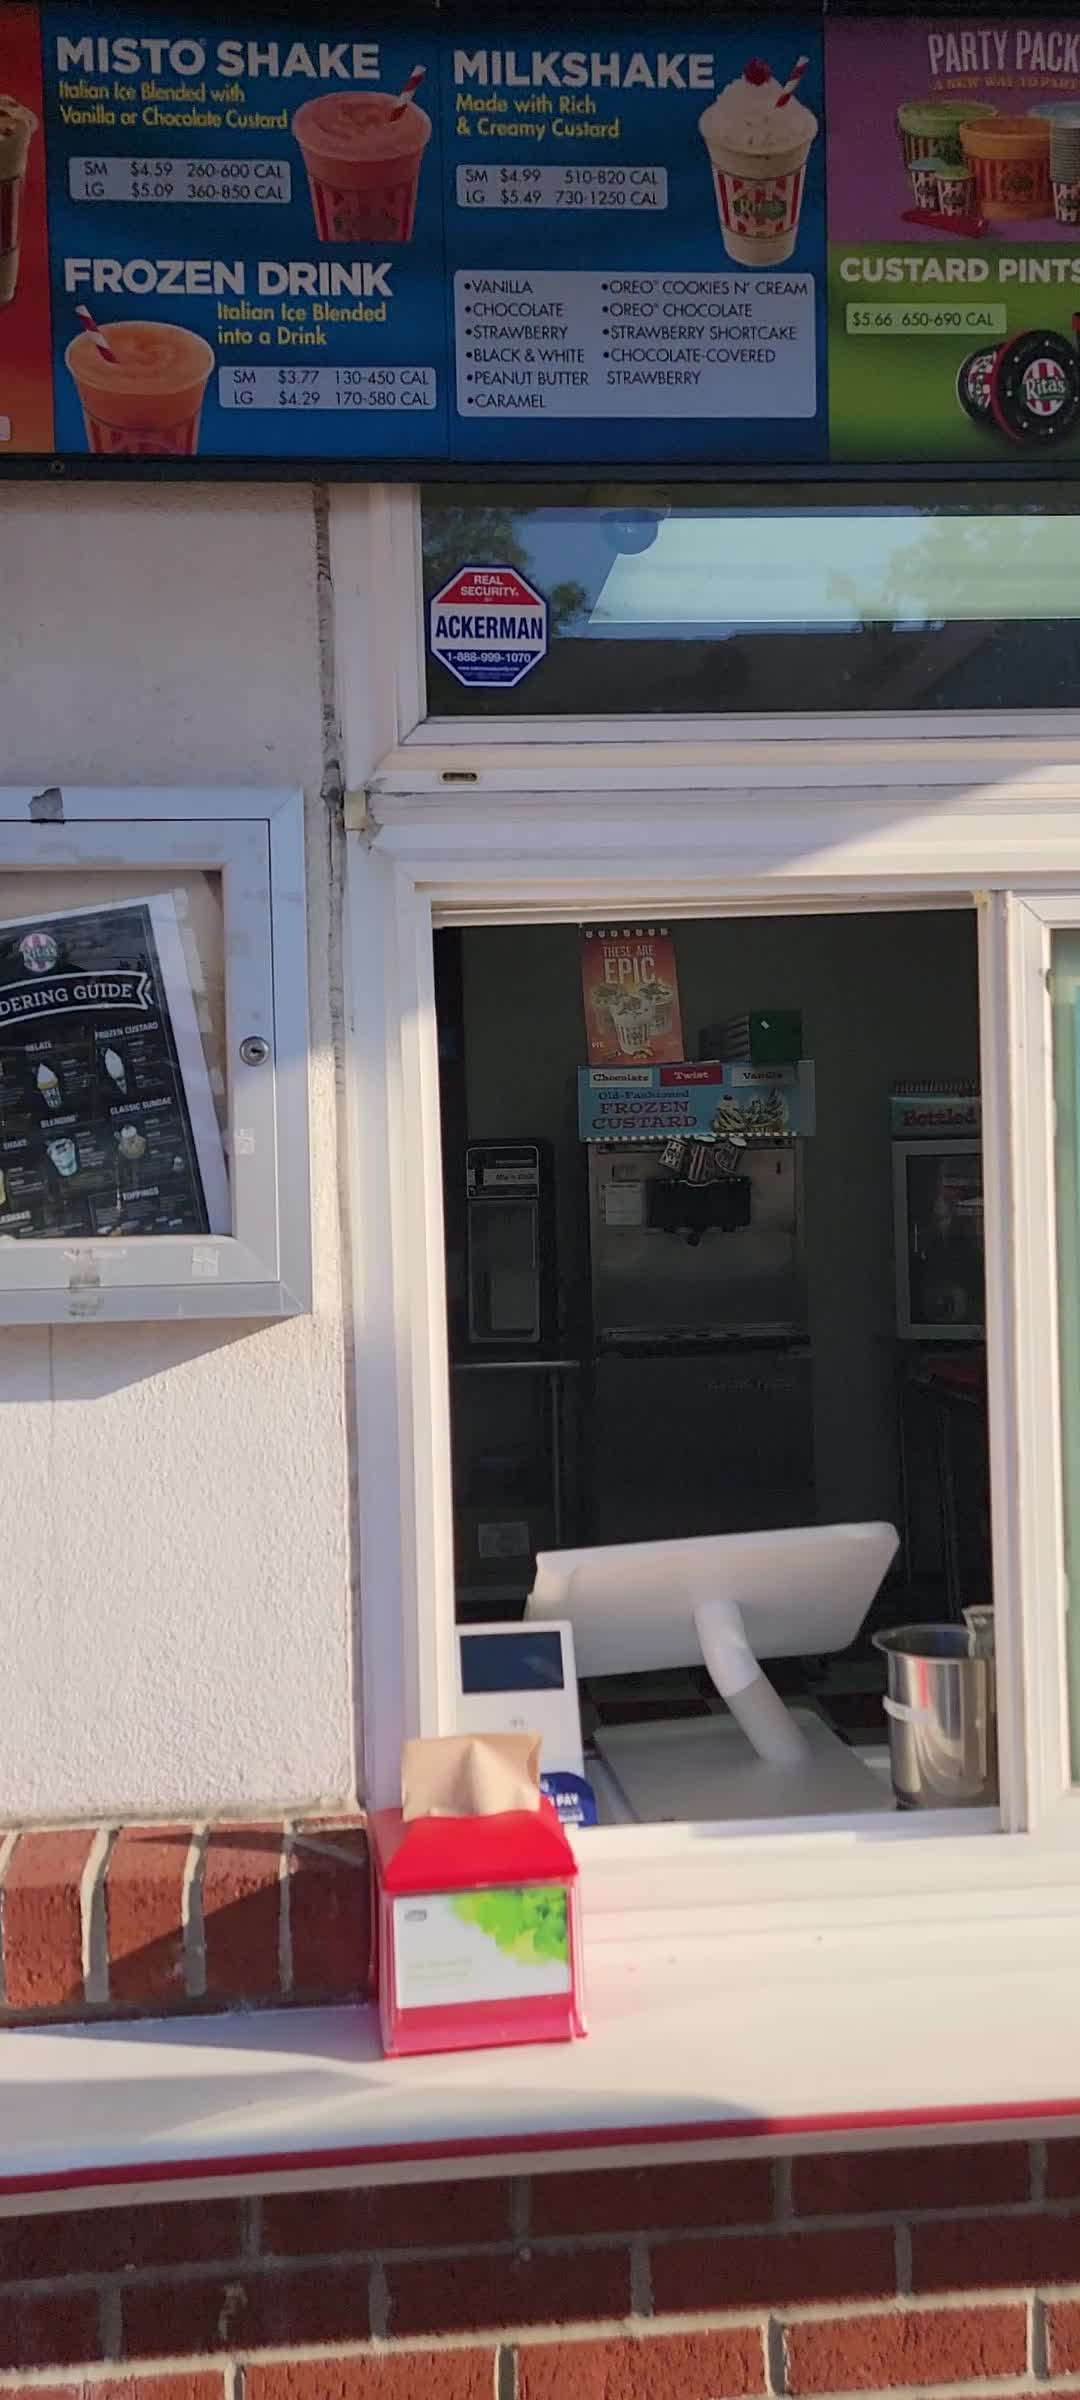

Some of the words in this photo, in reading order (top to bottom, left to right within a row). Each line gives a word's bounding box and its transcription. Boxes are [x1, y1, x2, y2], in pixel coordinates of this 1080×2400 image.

[216, 41, 380, 79] SHAKE
[928, 30, 1008, 75] PARTY
[1016, 30, 1080, 74] PACK
[453, 50, 715, 89] MILKSHAKE
[59, 81, 112, 100] Italian
[114, 85, 136, 101] Ice
[141, 84, 206, 102] Blended
[211, 85, 245, 103] with
[456, 95, 508, 113] Made
[515, 95, 552, 114] with
[558, 96, 597, 114] Rich
[60, 105, 114, 124] Vanilla
[116, 109, 137, 125] or
[142, 107, 223, 128] Chocolate
[226, 110, 287, 129] Custard
[456, 120, 470, 136] &
[477, 118, 546, 142] Creamy
[551, 119, 620, 139] Custard
[84, 162, 107, 176] SM
[131, 161, 173, 178] $4.59
[187, 163, 250, 178] 260-600
[254, 164, 284, 179] CAL
[465, 170, 488, 183] SM
[500, 169, 541, 185] $4.99
[563, 171, 626, 185] 510-820
[630, 171, 659, 186] CAL
[85, 183, 105, 197] LG
[131, 182, 173, 198] $5.09
[188, 183, 250, 199] 360-850
[254, 185, 284, 200] CAL
[465, 190, 486, 205] LG
[500, 190, 541, 206] $5.49
[555, 191, 626, 206] 730-1250
[630, 191, 659, 206] CAL
[64, 257, 244, 294] FROZEN
[258, 261, 393, 296] DRINK
[840, 257, 989, 283] CUSTARD
[999, 257, 1080, 283] PINTS
[471, 280, 533, 294] VANILLA
[663, 281, 729, 295] COOKIES
[755, 281, 809, 296] CREAM
[217, 303, 274, 322] Italian
[281, 306, 306, 322] Ice
[313, 303, 387, 322] Blended
[472, 302, 564, 318] CHOCOLATE
[662, 304, 753, 318] CHOCOLATE
[852, 310, 893, 328] $5.66
[901, 310, 962, 328] 650-690
[965, 311, 994, 327] CAL
[218, 327, 253, 346] into
[259, 333, 271, 346] a
[277, 327, 327, 346] Drink
[473, 325, 568, 341] STRAWBERRY
[610, 326, 705, 341] STRAWBERRY
[709, 326, 798, 341] SHORTCAKE
[473, 348, 521, 363] BLACK
[524, 349, 537, 363] &
[538, 348, 585, 363] WHITE
[610, 348, 776, 363] CHOCOLATE-COVERED
[233, 370, 256, 385] SM
[278, 369, 319, 386] $3.77
[335, 370, 396, 386] 130-450
[399, 370, 430, 386] CAL
[474, 371, 532, 385] PEANUT
[538, 371, 590, 386] BUTTER
[607, 371, 701, 386] STRAWBERRY
[1026, 378, 1066, 402] Rita's
[234, 391, 254, 406] LG
[279, 391, 321, 407] $4.29
[335, 391, 396, 407] 170-580
[399, 391, 430, 407] CAL
[474, 393, 547, 408] CARAMEL
[474, 575, 504, 585] REAL
[435, 615, 543, 639] ACKERMAN
[446, 652, 531, 663] 1-888-999-1070
[602, 945, 632, 957] THESE
[636, 944, 655, 956] ARE
[73, 982, 133, 1002] GUIDE
[592, 1073, 649, 1082] Chocolate
[673, 1071, 710, 1080] Twist
[601, 1102, 689, 1114] FROZEN
[592, 1116, 698, 1130] CUSTARD
[555, 1791, 579, 1807] PAY
